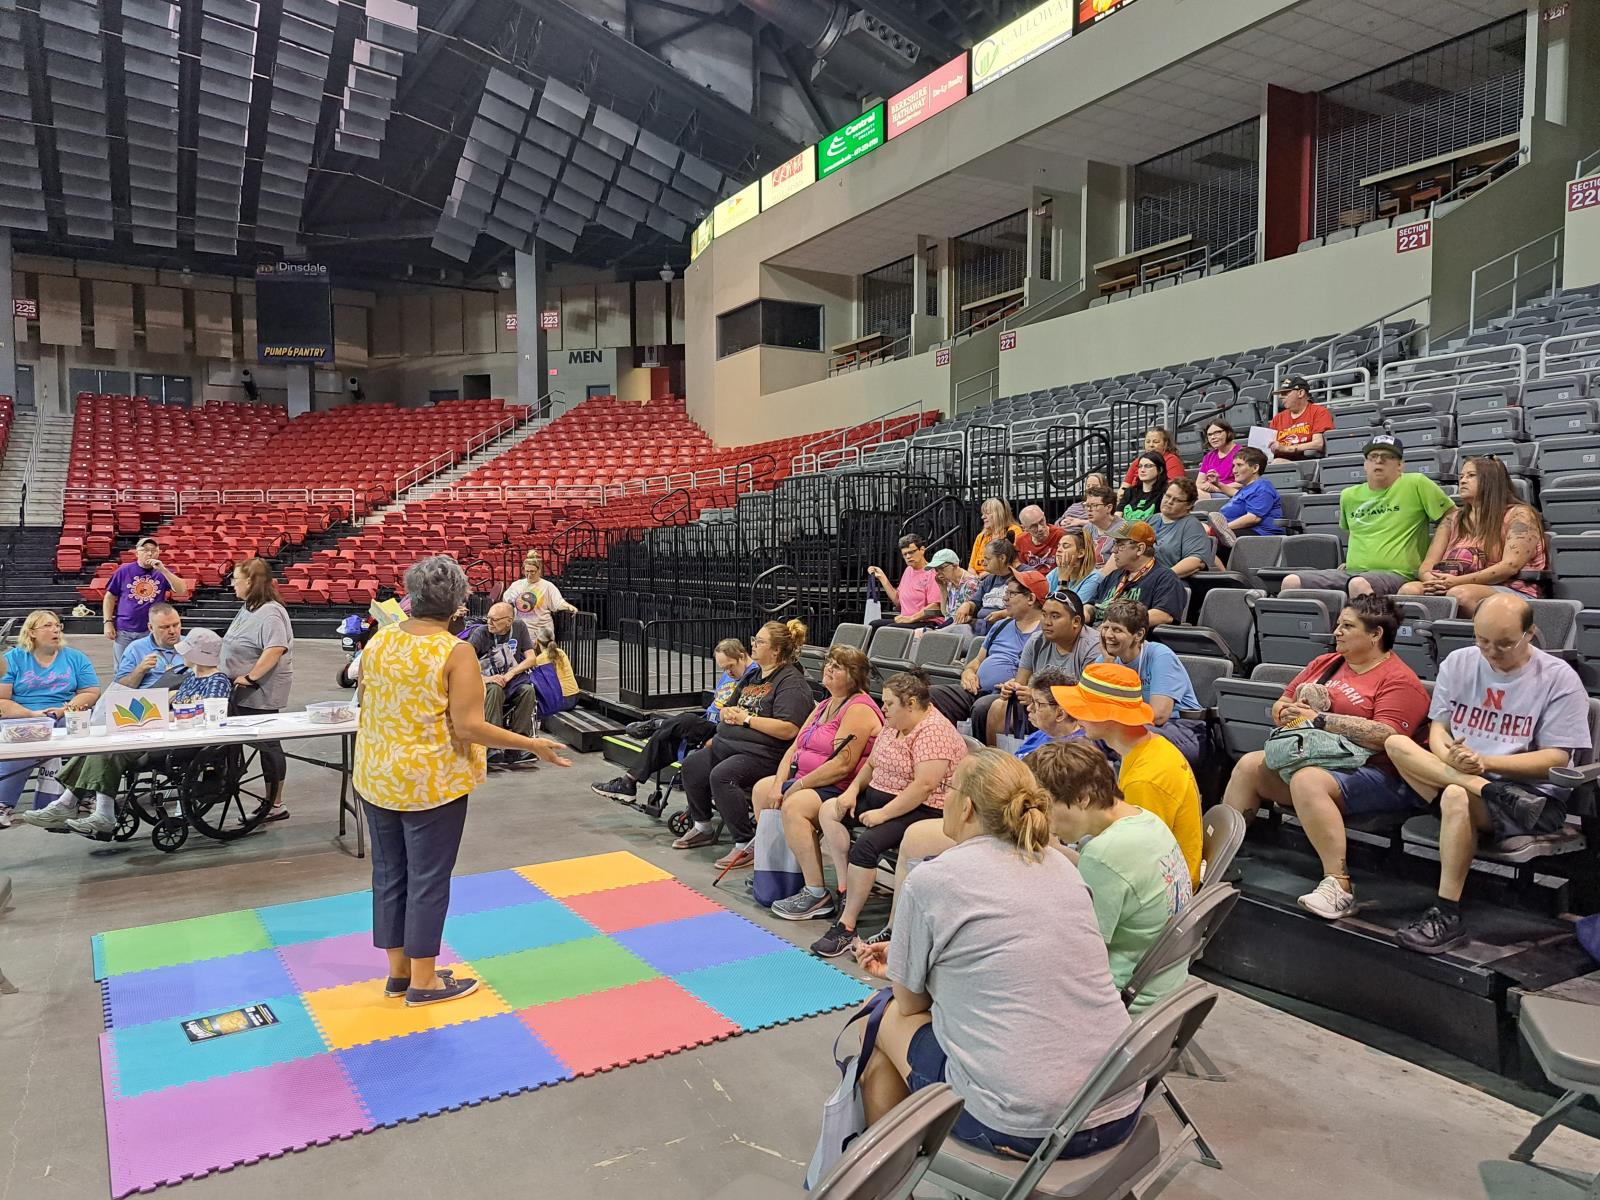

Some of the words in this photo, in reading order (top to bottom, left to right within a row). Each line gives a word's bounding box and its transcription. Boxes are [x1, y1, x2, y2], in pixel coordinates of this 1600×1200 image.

[891, 86, 928, 114] BERKSHIRE
[892, 97, 926, 123] HATHAWAY
[845, 111, 876, 136] Central
[1399, 222, 1429, 237] SECTION
[1399, 231, 1427, 251] 221
[280, 262, 327, 273] Dinsdale
[16, 304, 36, 313] 225
[506, 318, 518, 326] 22
[543, 316, 558, 324] 223
[1001, 338, 1014, 350] 221
[568, 350, 603, 364] MEN
[937, 355, 949, 365] 222
[1482, 688, 1505, 710] N
[1467, 707, 1498, 733] BIG
[1500, 713, 1532, 737] RED
